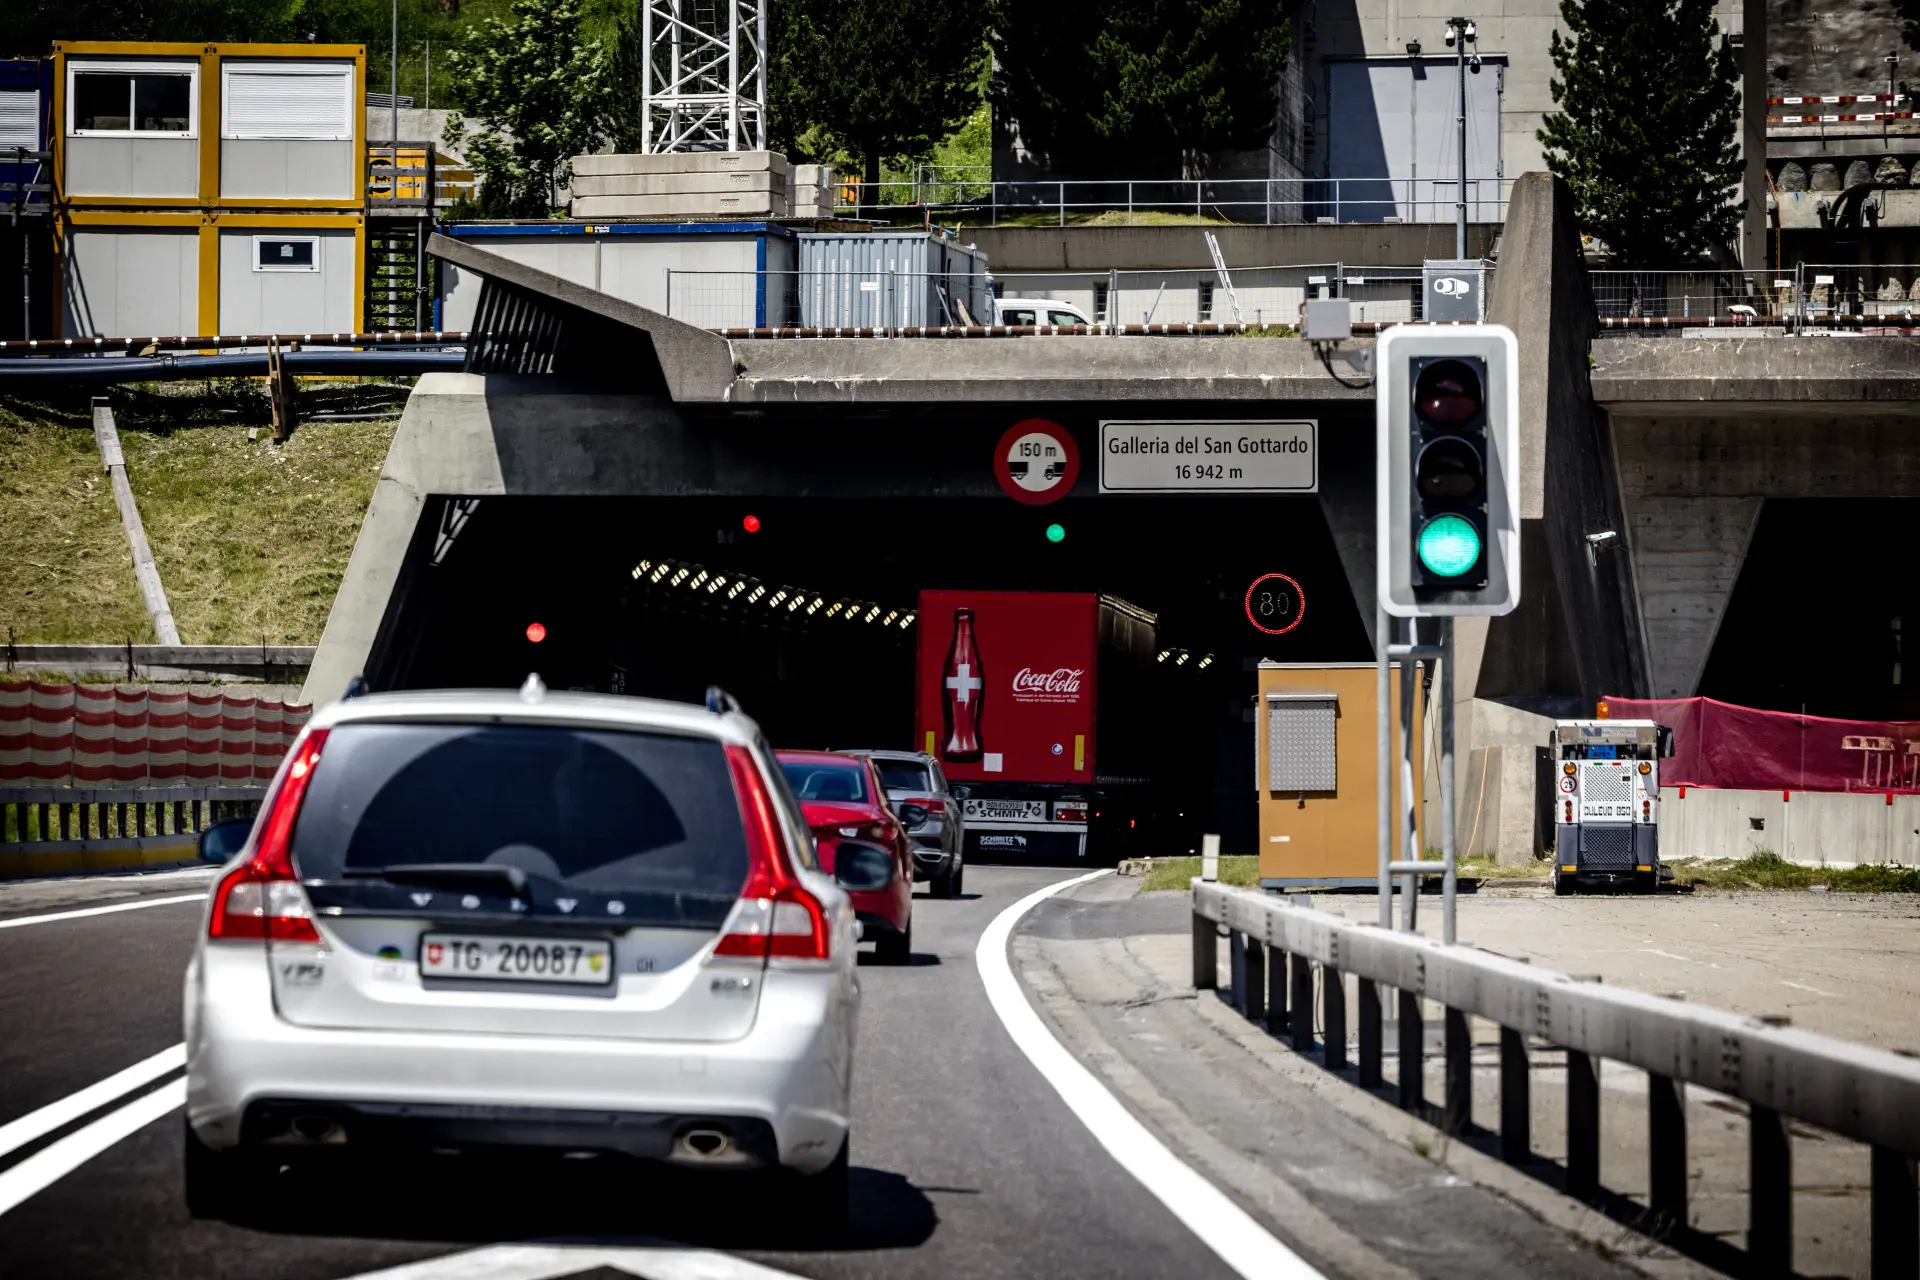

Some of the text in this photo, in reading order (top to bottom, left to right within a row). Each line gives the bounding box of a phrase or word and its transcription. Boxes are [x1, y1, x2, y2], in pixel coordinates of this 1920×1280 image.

[1018, 443, 1057, 457] 150 m
[1108, 437, 1309, 455] Galleria del San Gottardo
[1175, 464, 1243, 480] 16 942 m
[1259, 591, 1290, 616] 80
[1012, 667, 1085, 693] Coca-Cola
[1563, 780, 1573, 789] 25
[980, 809, 1029, 819] SCHMITZ
[1583, 806, 1631, 816] DULEVO 850
[450, 939, 583, 976] TG 20087
